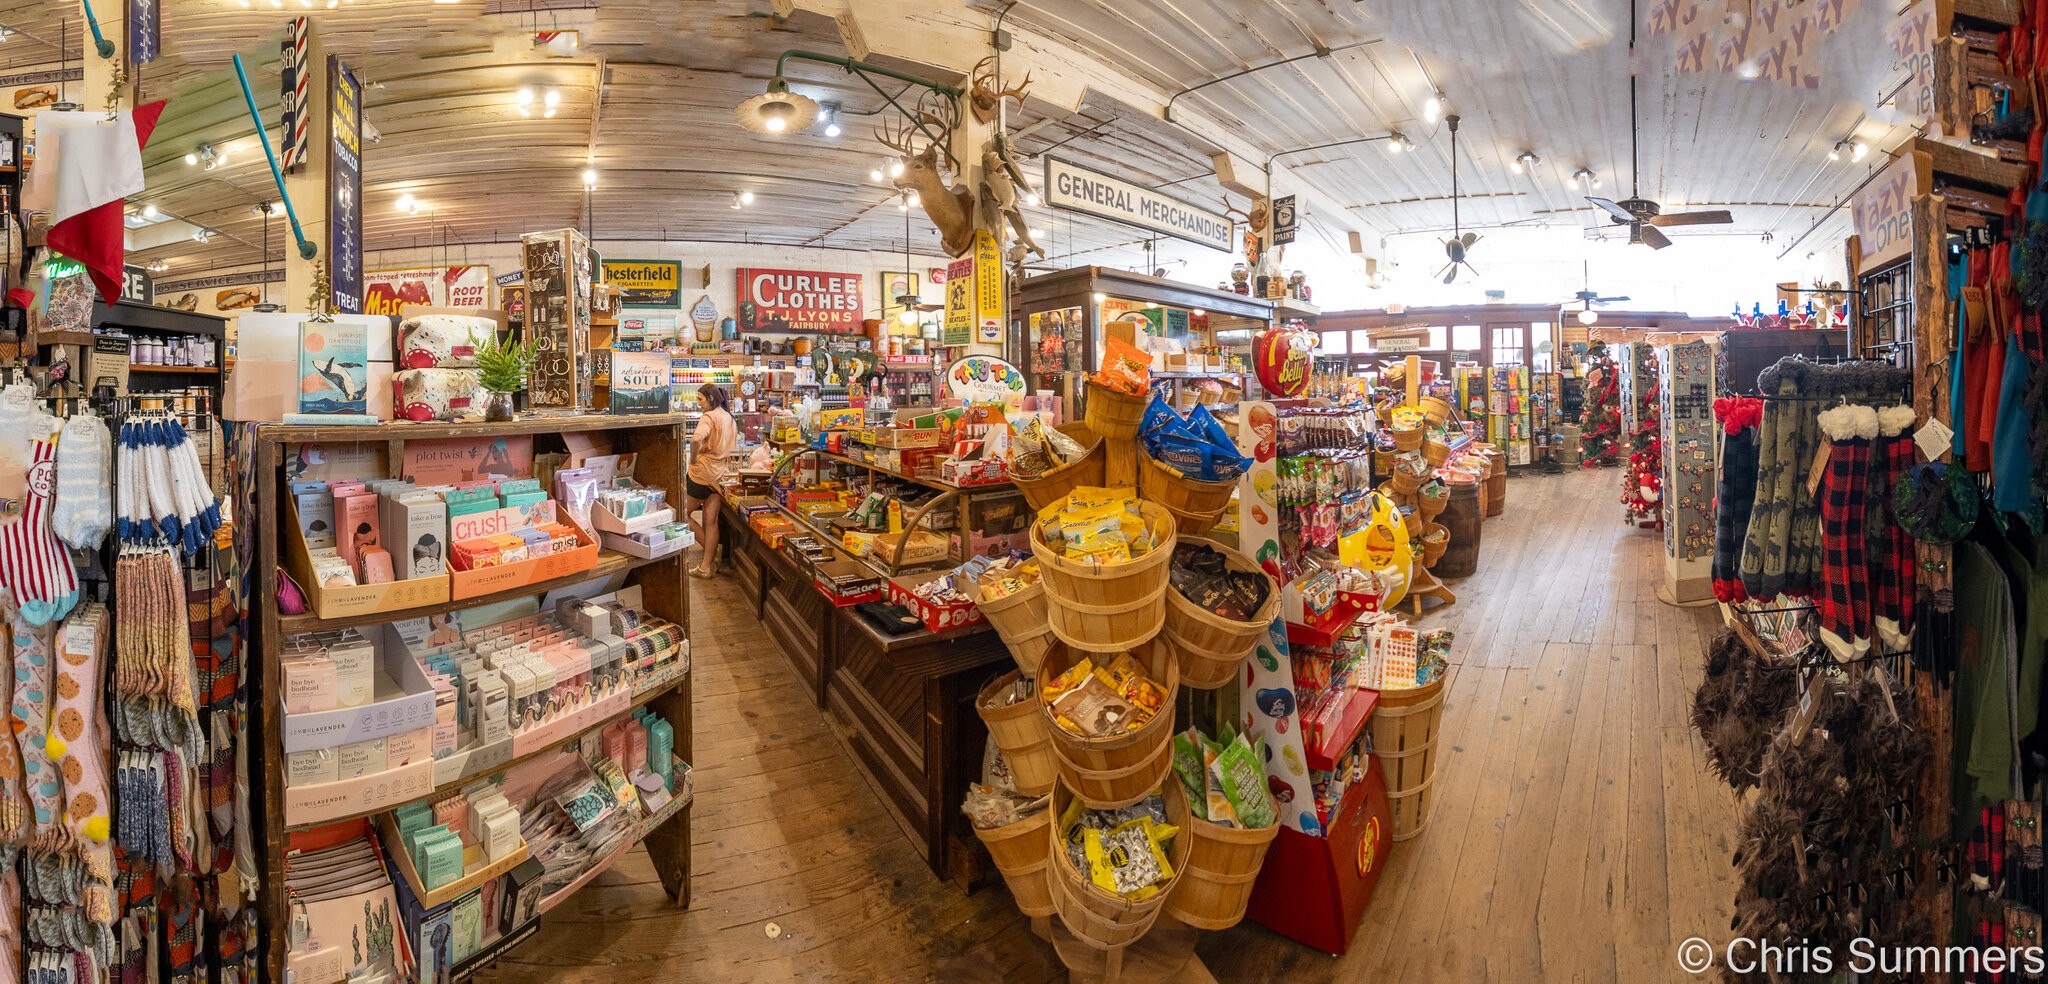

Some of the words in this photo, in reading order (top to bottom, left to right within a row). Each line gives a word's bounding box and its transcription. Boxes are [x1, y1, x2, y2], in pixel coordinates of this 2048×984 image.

[339, 75, 354, 101] CHEW
[336, 90, 355, 128] MAIL
[333, 111, 359, 156] POUCH
[334, 139, 358, 173] TOBACCO
[1057, 172, 1134, 213] GENERAL
[1139, 196, 1229, 243] MERCHANDISE
[1274, 230, 1295, 241] PAINT
[178, 277, 235, 289] SERVICE
[497, 273, 522, 285] MONEY
[453, 286, 484, 296] ROOT
[752, 274, 857, 303] CURLEE
[335, 290, 359, 312] TREAT
[453, 297, 483, 306] BEER
[752, 285, 859, 310] CLOTHES
[1104, 301, 1128, 310] ELVIS
[798, 310, 853, 322] LYONS
[789, 321, 830, 329] FAIRBURY
[905, 355, 917, 364] SOLD
[917, 355, 929, 364] HERE
[1278, 358, 1304, 384] Belly
[623, 375, 663, 386] SOUL
[991, 363, 1024, 392] TOWN
[973, 382, 1007, 392] GOURMET
[913, 431, 933, 441] BUN
[416, 451, 437, 463] plot
[440, 450, 464, 460] twist
[455, 510, 507, 540] crush
[291, 683, 319, 692] bedhead
[341, 755, 369, 765] bedhead
[292, 764, 321, 773] bedhead
